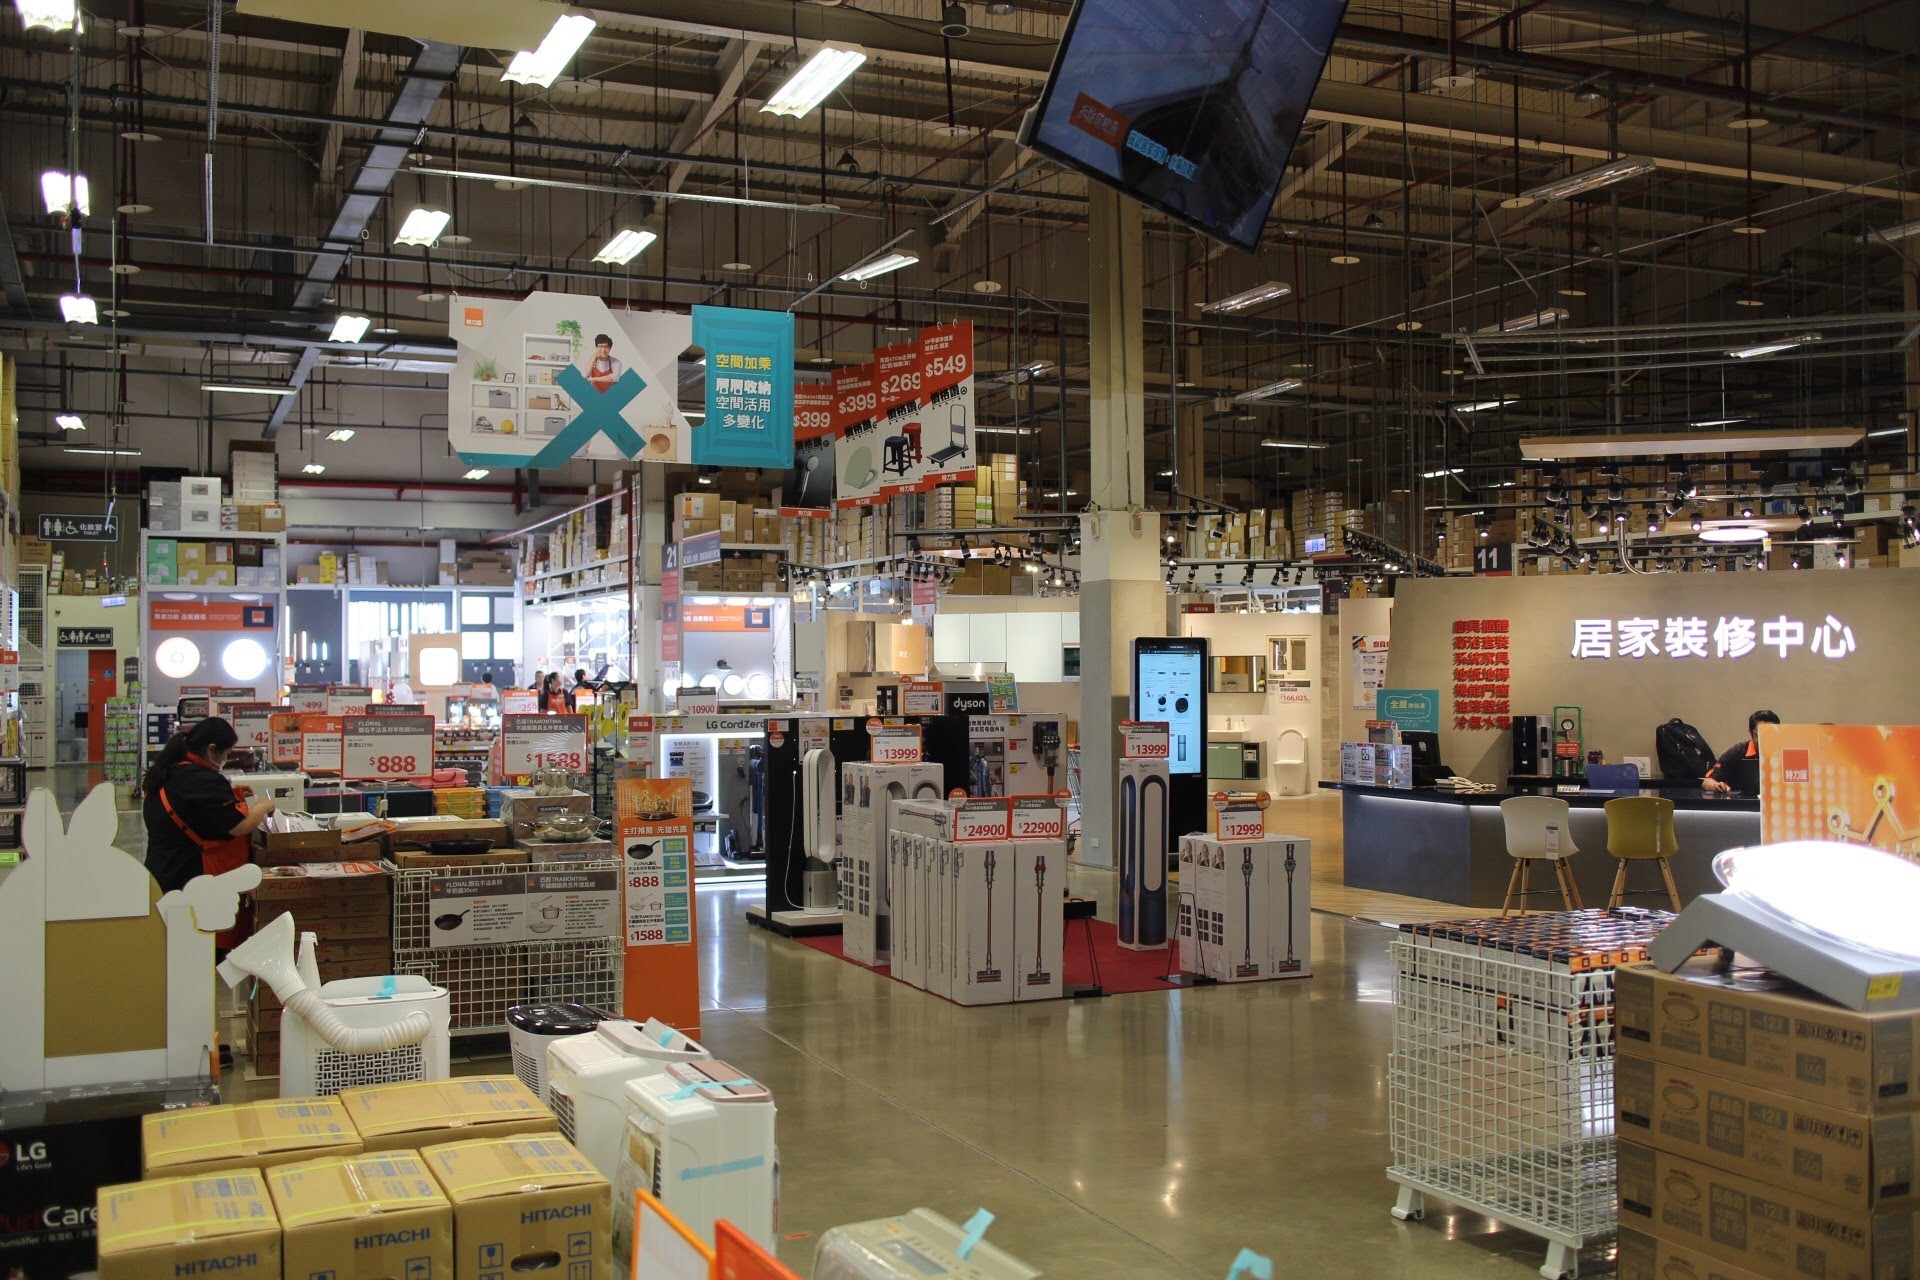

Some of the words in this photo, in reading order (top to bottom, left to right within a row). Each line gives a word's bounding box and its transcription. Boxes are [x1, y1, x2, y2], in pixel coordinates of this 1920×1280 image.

[716, 354, 772, 370] 空間加乘
[925, 354, 966, 377] $549
[881, 372, 920, 394] $269
[716, 396, 771, 412] 空間活用
[838, 393, 876, 414] $399
[723, 413, 764, 429] 多變化
[793, 411, 831, 428] $399
[666, 546, 677, 569] 21
[1477, 547, 1498, 570] 11
[1571, 615, 1856, 658] 居家裝修中心
[1453, 652, 1509, 666] 系統家具
[303, 701, 322, 709] $499
[688, 705, 715, 714] $10900
[954, 698, 986, 711] dyson
[706, 720, 718, 729] LG
[880, 748, 918, 760] $13999
[1132, 744, 1167, 755] $13999
[369, 755, 416, 773] $888
[1785, 770, 1808, 780] 特力屋
[964, 824, 1005, 837] $24900
[1019, 822, 1059, 834] $22900
[1226, 824, 1262, 835] $12999
[629, 876, 659, 888] $888
[631, 929, 664, 941] $1588
[16, 1142, 47, 1162] LG
[521, 1204, 591, 1224] HITACHI
[355, 1227, 431, 1249] HITACHI
[175, 1253, 257, 1277] HITACHI
